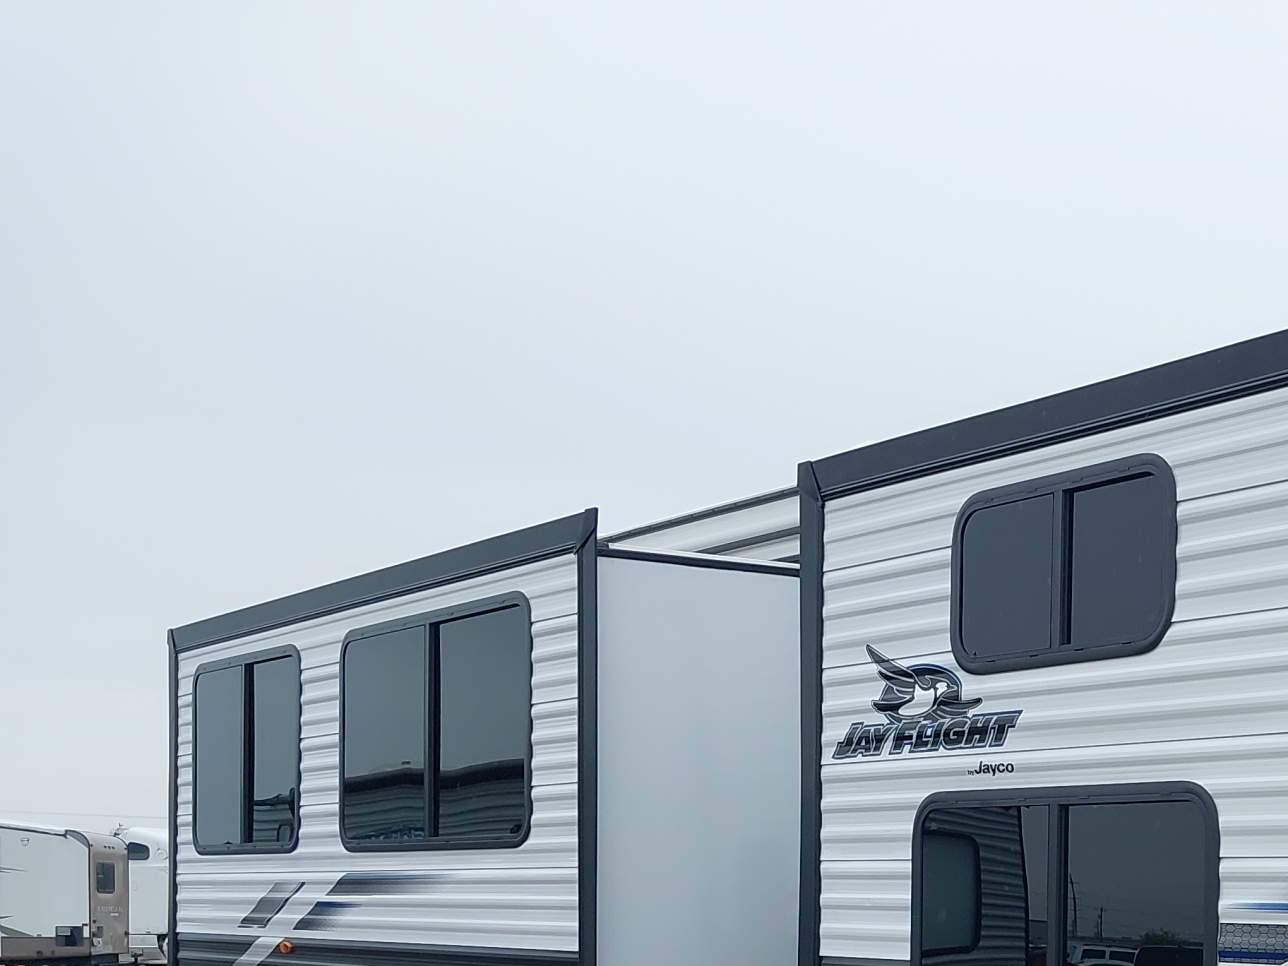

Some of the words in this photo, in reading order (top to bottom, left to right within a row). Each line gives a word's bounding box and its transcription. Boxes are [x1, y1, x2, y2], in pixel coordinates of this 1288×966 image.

[832, 721, 899, 759] JAY
[888, 710, 1023, 755] FLIGHT
[974, 760, 1015, 776] Jayco
